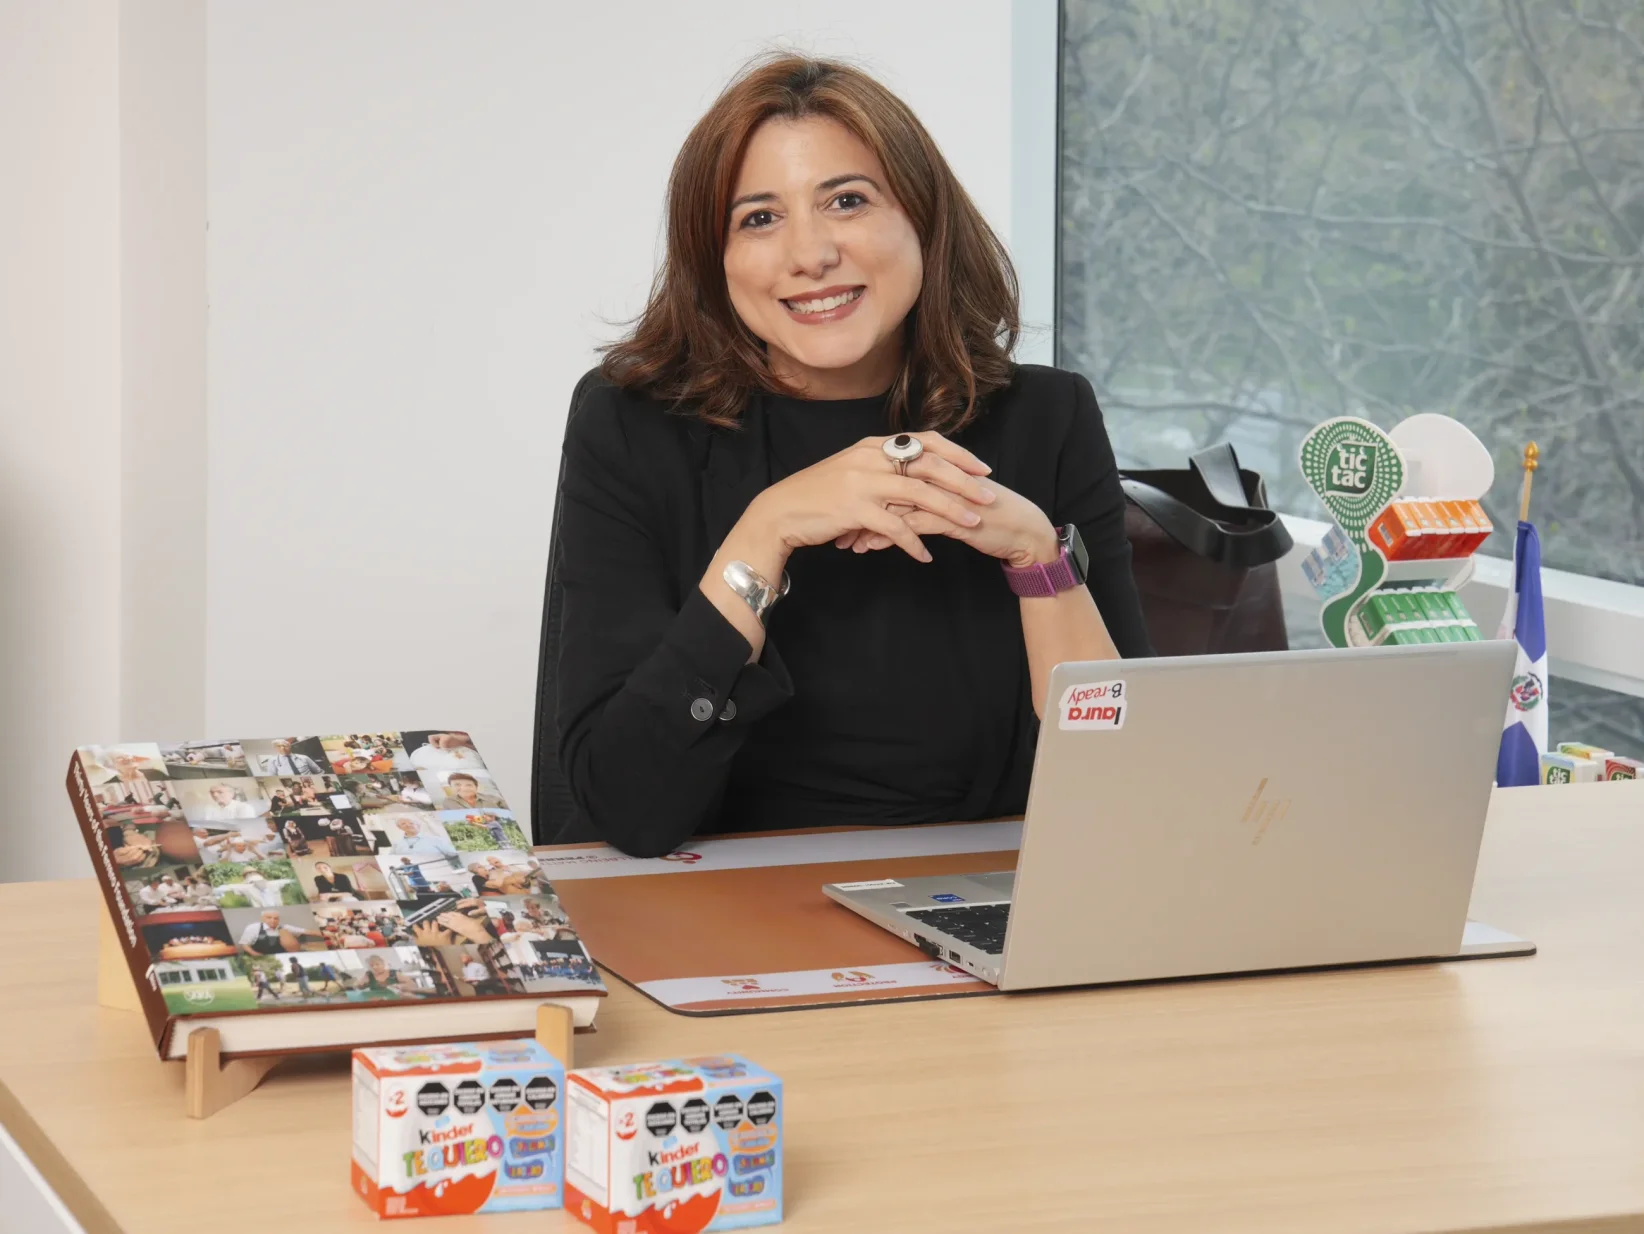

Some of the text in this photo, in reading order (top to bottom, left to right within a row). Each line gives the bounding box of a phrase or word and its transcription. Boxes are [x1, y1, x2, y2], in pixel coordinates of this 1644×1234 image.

[1339, 448, 1367, 470] tic
[1331, 465, 1366, 488] tac
[1067, 683, 1122, 705] B-ready
[1067, 707, 1122, 725] laura
[1552, 767, 1569, 779] tic
[403, 1149, 428, 1178] TE
[427, 1134, 504, 1171] QUIERO
[633, 1171, 657, 1200] TE
[656, 1152, 728, 1192] QUIERO
